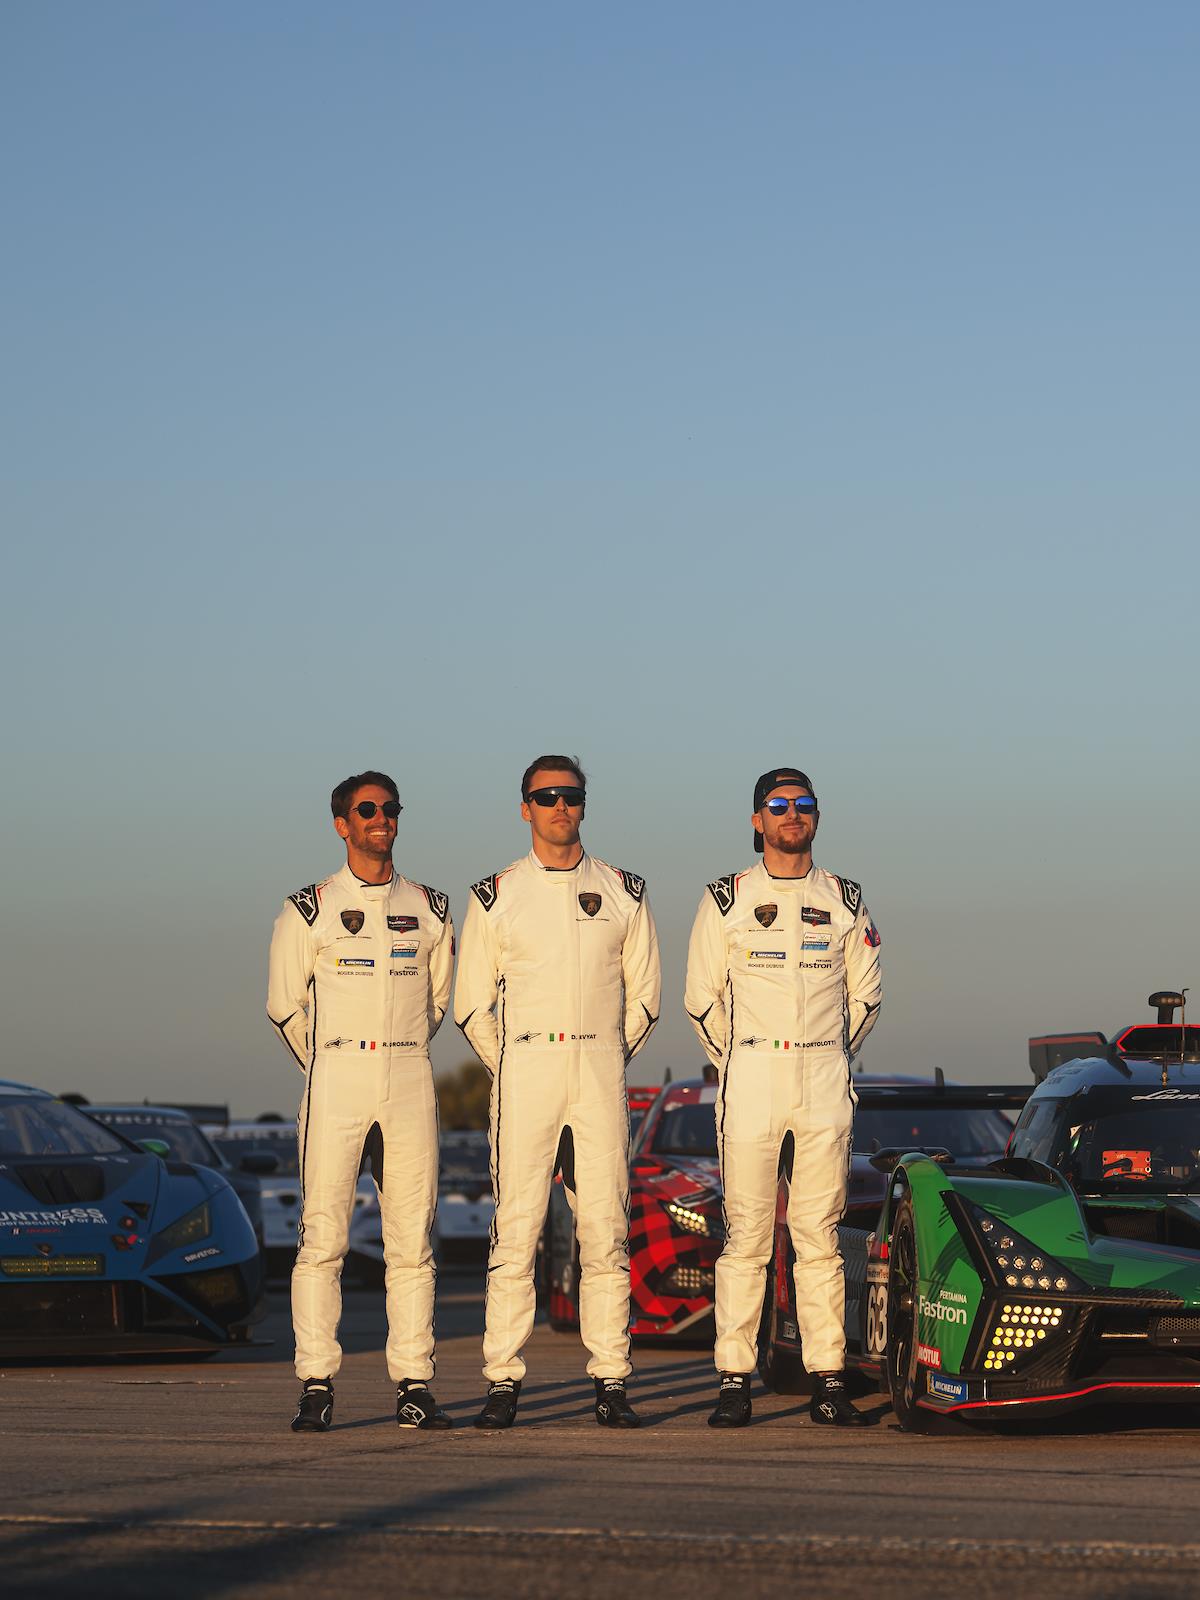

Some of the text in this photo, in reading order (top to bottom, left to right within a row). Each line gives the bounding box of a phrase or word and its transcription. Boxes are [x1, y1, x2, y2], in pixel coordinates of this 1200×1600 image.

[389, 969, 419, 977] Fastron
[799, 961, 832, 970] Fastron
[939, 1289, 968, 1304] PERTAMINA
[919, 1295, 967, 1325] Fastron
[867, 1285, 888, 1353] 63
[918, 1345, 940, 1365] MOTUL
[935, 1380, 962, 1395] MICHELIN
